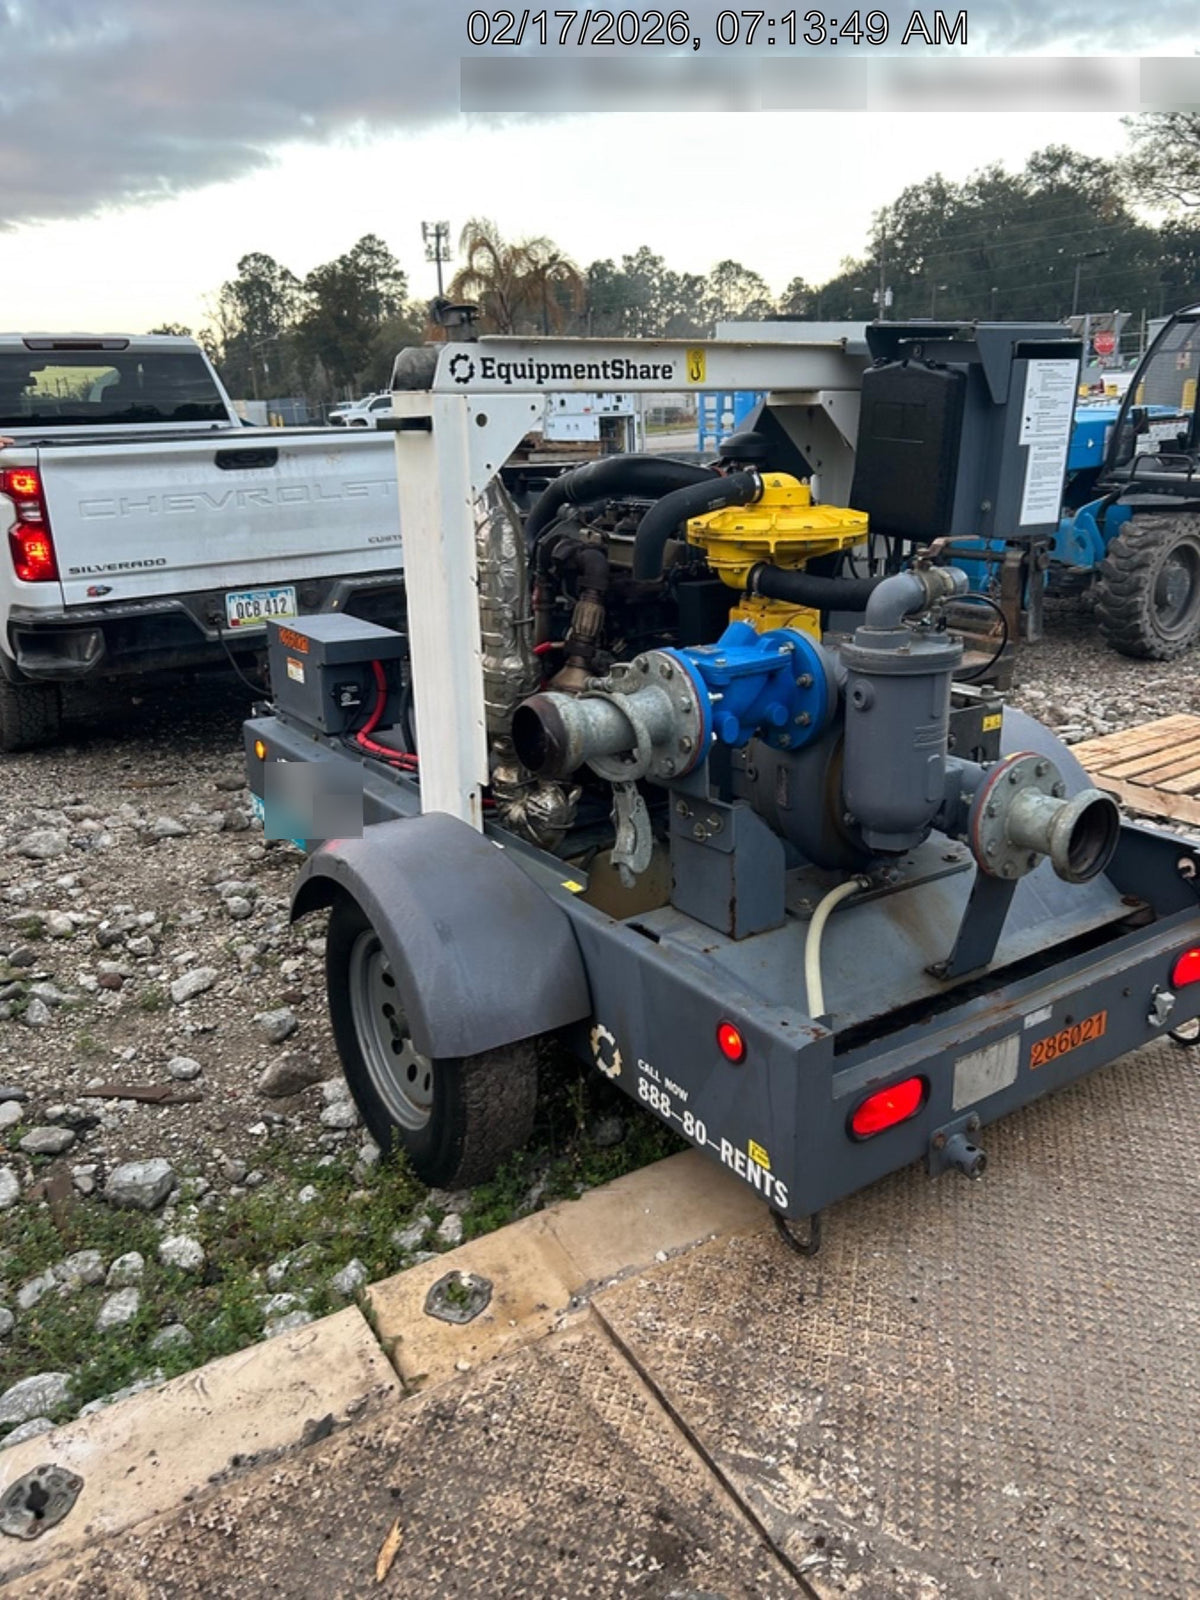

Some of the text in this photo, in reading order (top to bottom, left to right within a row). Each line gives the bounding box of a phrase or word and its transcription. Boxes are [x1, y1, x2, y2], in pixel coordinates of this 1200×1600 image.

[480, 357, 673, 384] EquipmentShare
[78, 478, 399, 520] CHEVROLET
[68, 557, 167, 575] SILVERADO
[264, 596, 288, 615] 412
[1031, 1014, 1104, 1068] 286021
[637, 1058, 689, 1102] CALL NOW
[637, 1076, 789, 1209] 888-80-RENTS
